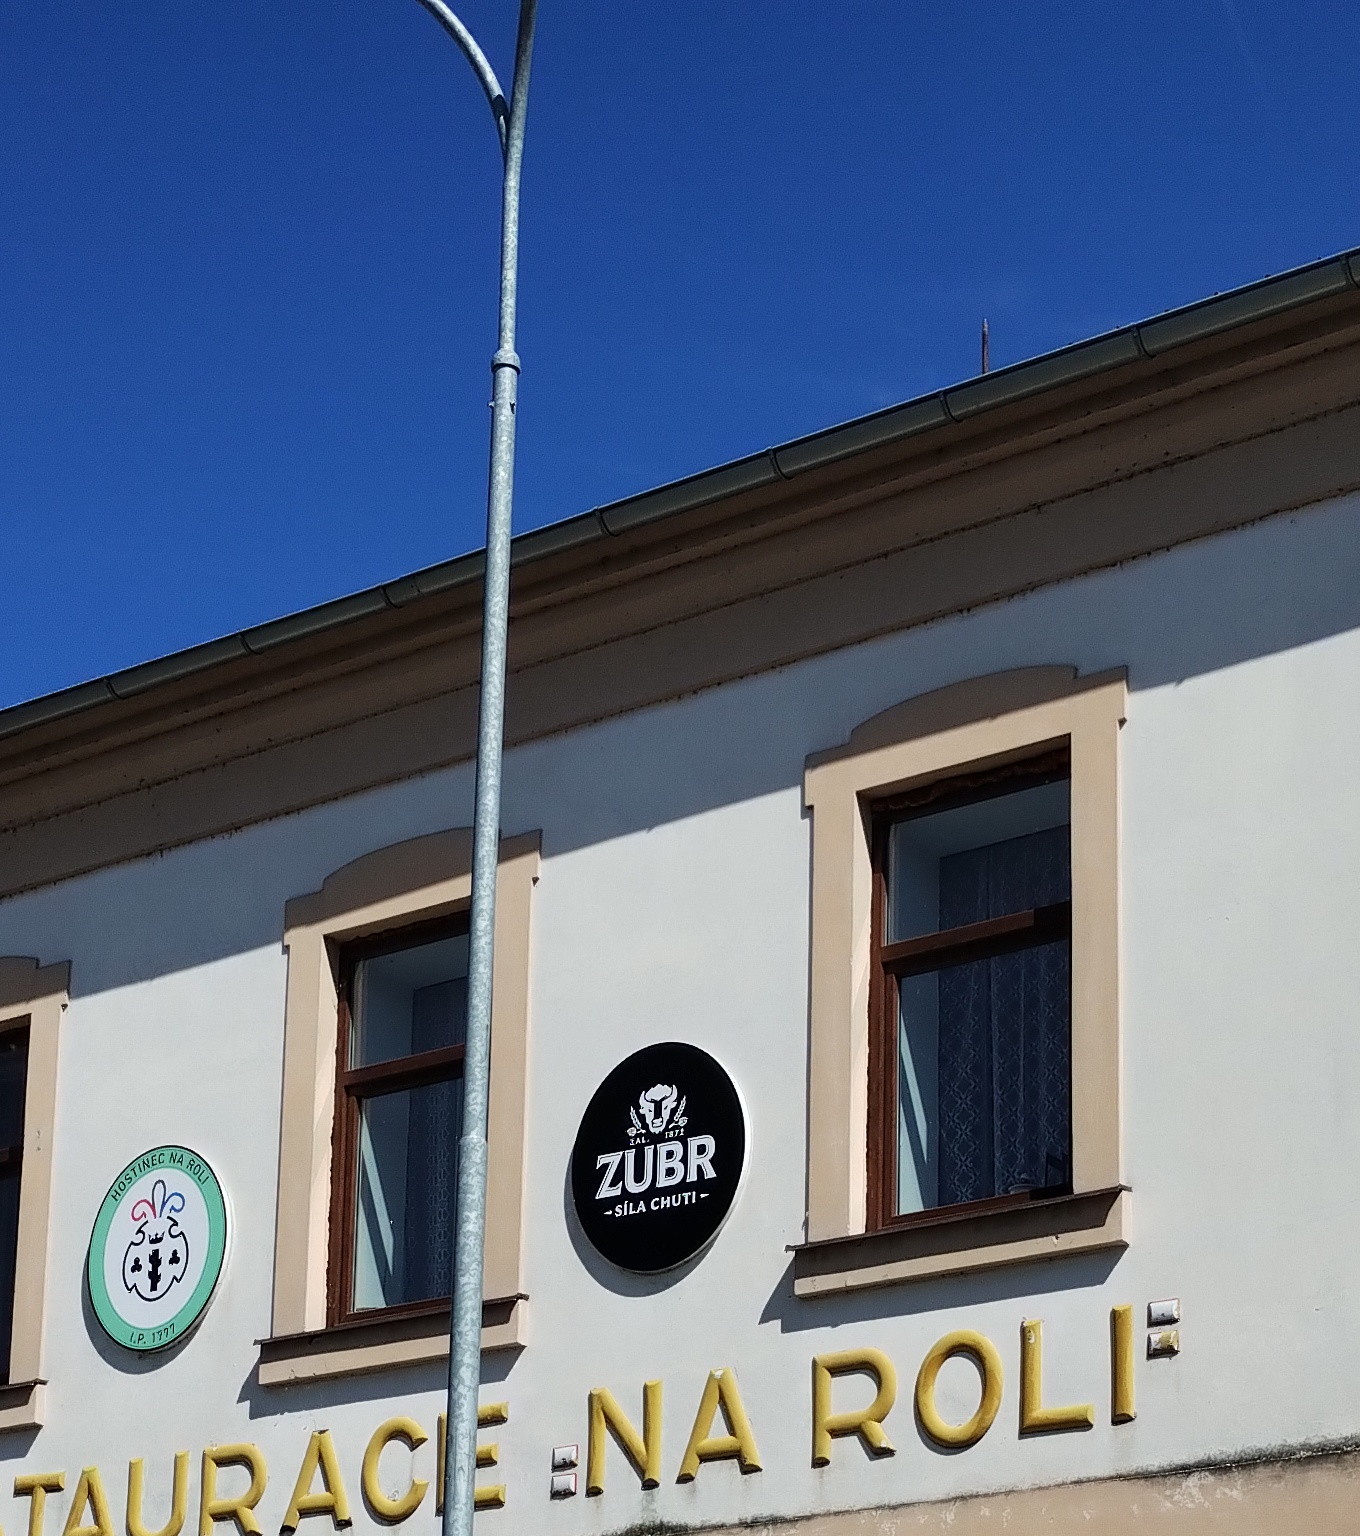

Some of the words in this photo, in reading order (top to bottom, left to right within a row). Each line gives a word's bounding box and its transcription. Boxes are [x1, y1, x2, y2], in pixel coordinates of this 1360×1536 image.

[111, 1153, 165, 1201] HOSTINEC
[169, 1152, 184, 1166] NA
[186, 1158, 209, 1185] ROLI
[595, 1135, 717, 1200] ZUBR
[615, 1201, 646, 1218] SÍLA
[650, 1191, 696, 1211] CHUTI
